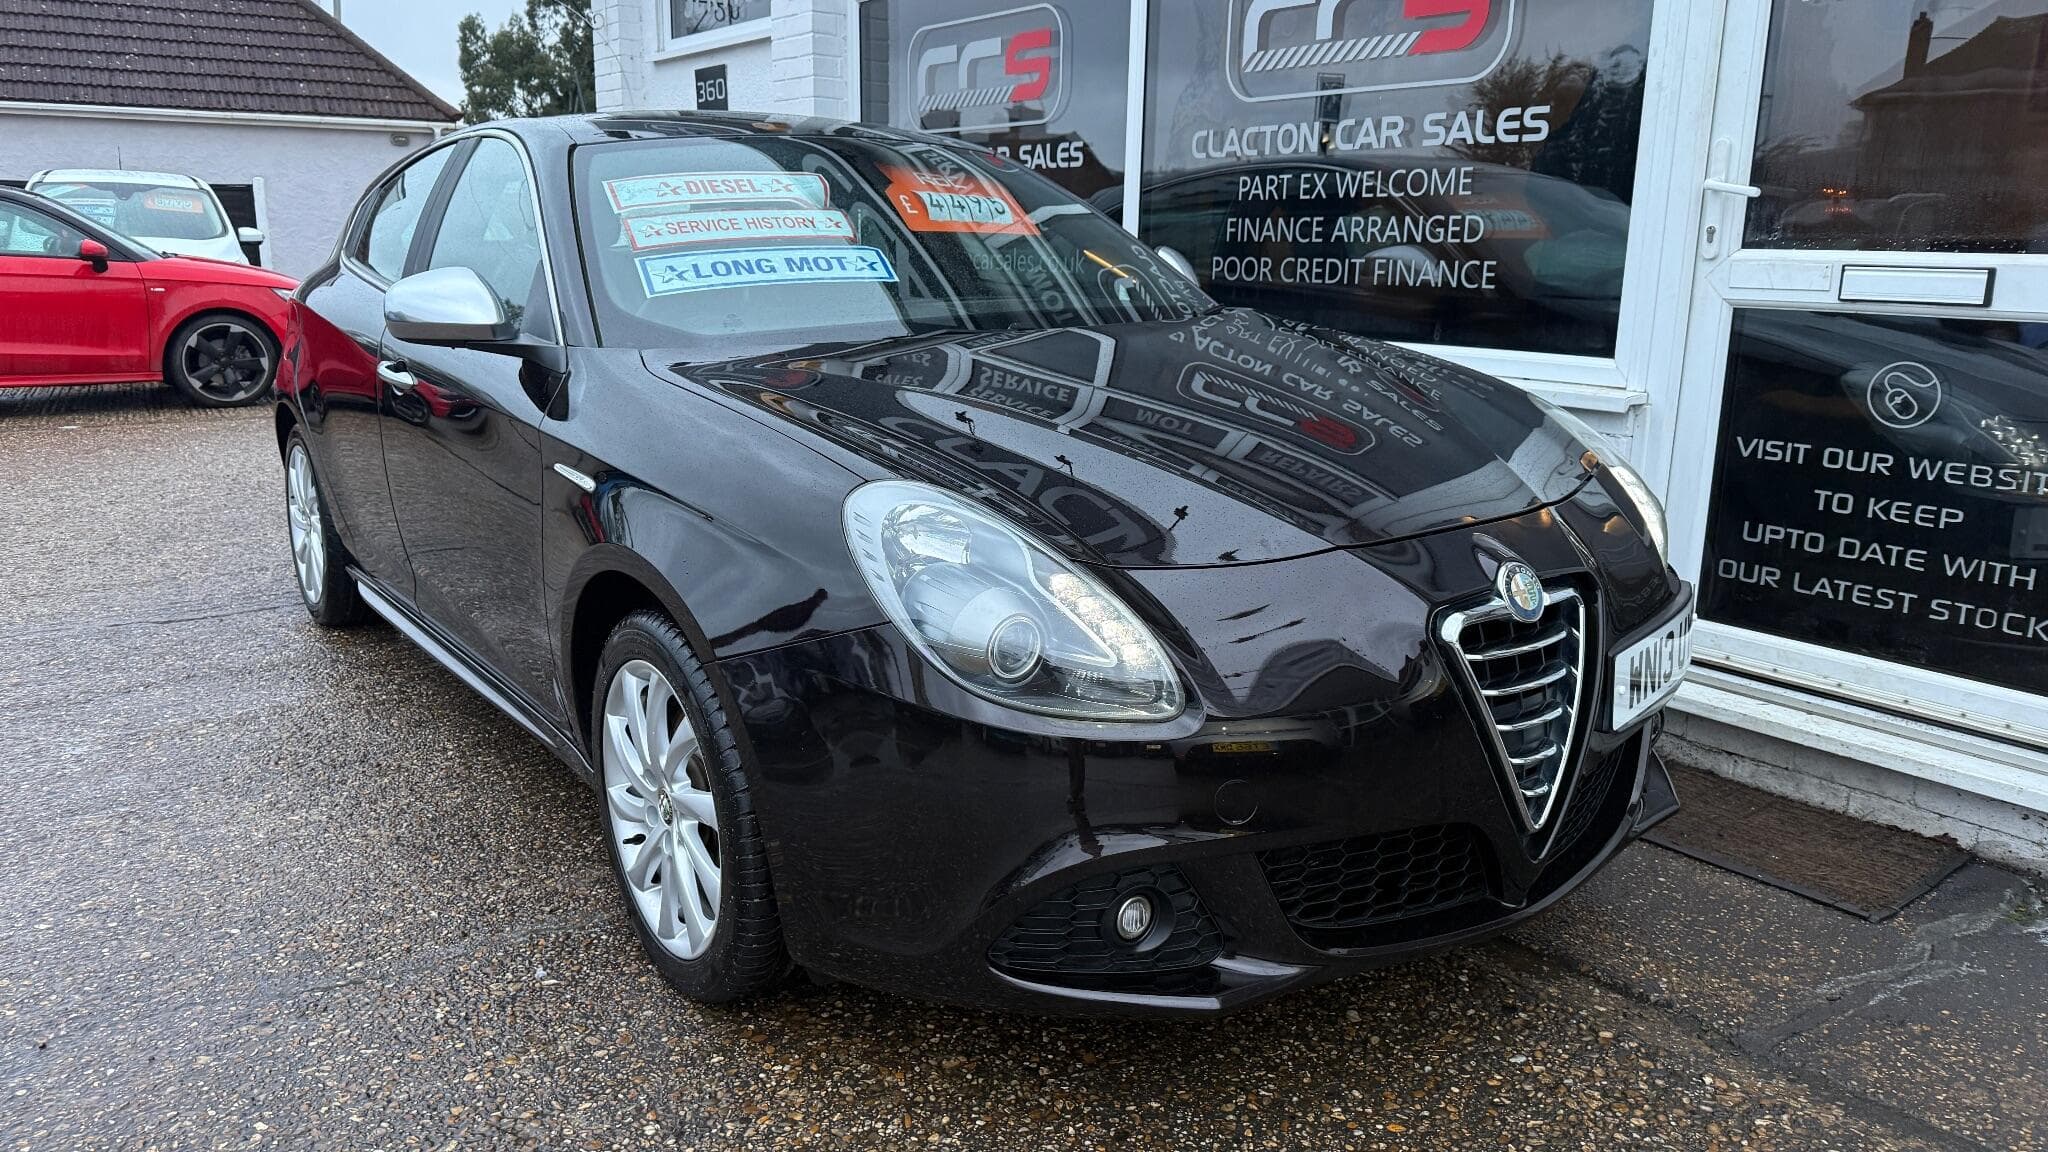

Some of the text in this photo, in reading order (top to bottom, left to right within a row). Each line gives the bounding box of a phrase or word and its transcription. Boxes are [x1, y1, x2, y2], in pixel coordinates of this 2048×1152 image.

[917, 27, 1051, 111] CCS
[697, 78, 726, 103] 360
[1191, 105, 1551, 158] CLACTON CAR SALES
[1019, 141, 1084, 170] SALES
[684, 178, 764, 196] DIESEL
[1239, 166, 1474, 200] PART EX WELCOME
[665, 216, 817, 236] SERVICE HISTORY
[1226, 217, 1324, 243] FINANCE
[1330, 215, 1485, 243] ARRANGED
[691, 256, 848, 280] LONG MOT
[1212, 256, 1497, 289] POOR CREDIT FINANCE
[1736, 436, 1812, 464] VISIT
[1822, 447, 1894, 476] OUR
[1814, 489, 1965, 529] TO KEEP
[1742, 521, 2037, 591] UPTO DATE WITH
[1718, 558, 2048, 642] OUR LATEST STOCK
